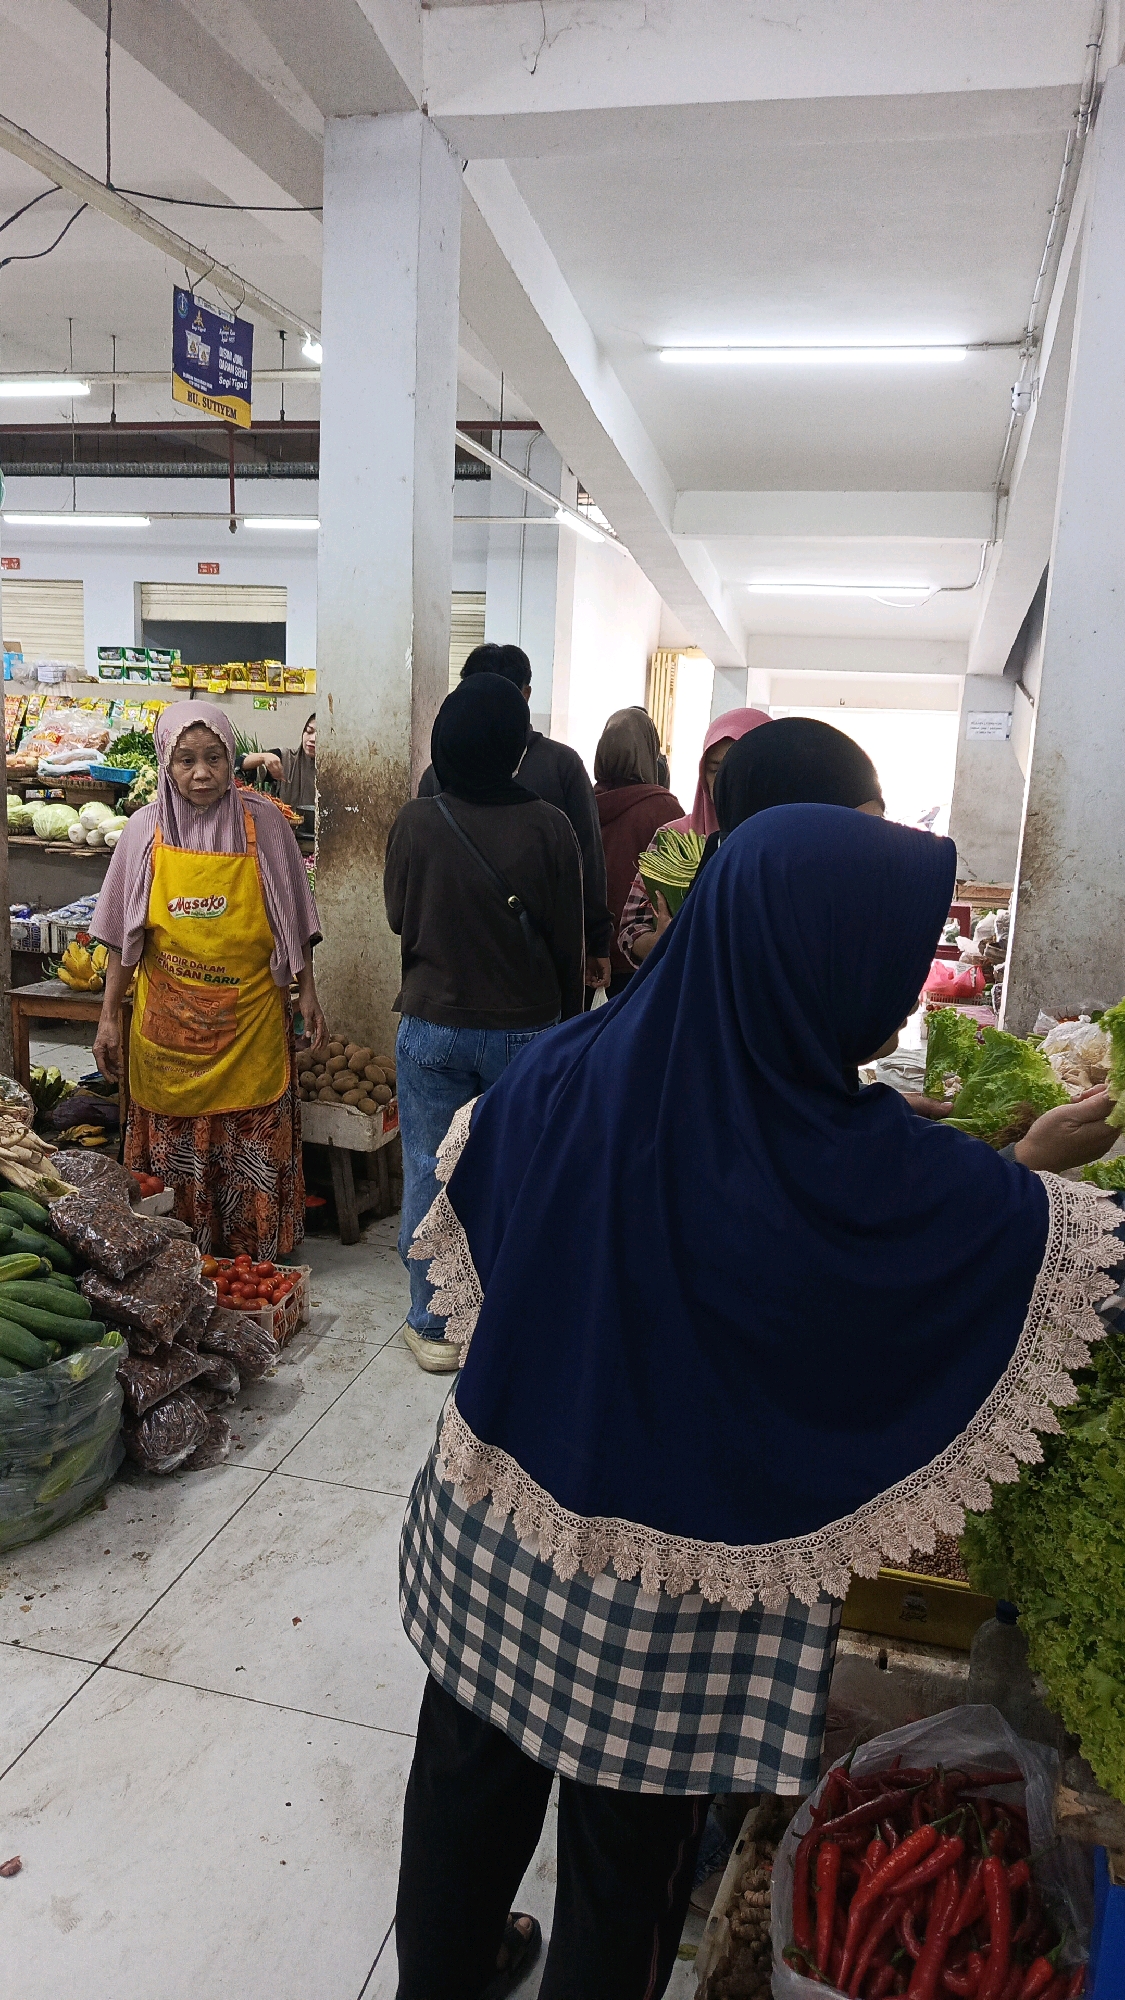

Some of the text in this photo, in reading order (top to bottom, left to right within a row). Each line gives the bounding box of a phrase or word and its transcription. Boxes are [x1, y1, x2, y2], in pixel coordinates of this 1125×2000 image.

[219, 358, 248, 380] GARAM SEHAT
[219, 375, 231, 389] Segi
[231, 378, 244, 391] Tiga
[188, 391, 237, 420] BU. SUTIYEM
[167, 895, 225, 914] Masako
[154, 953, 241, 985] EMASAN BARU
[161, 951, 226, 974] HADIR DALAM
